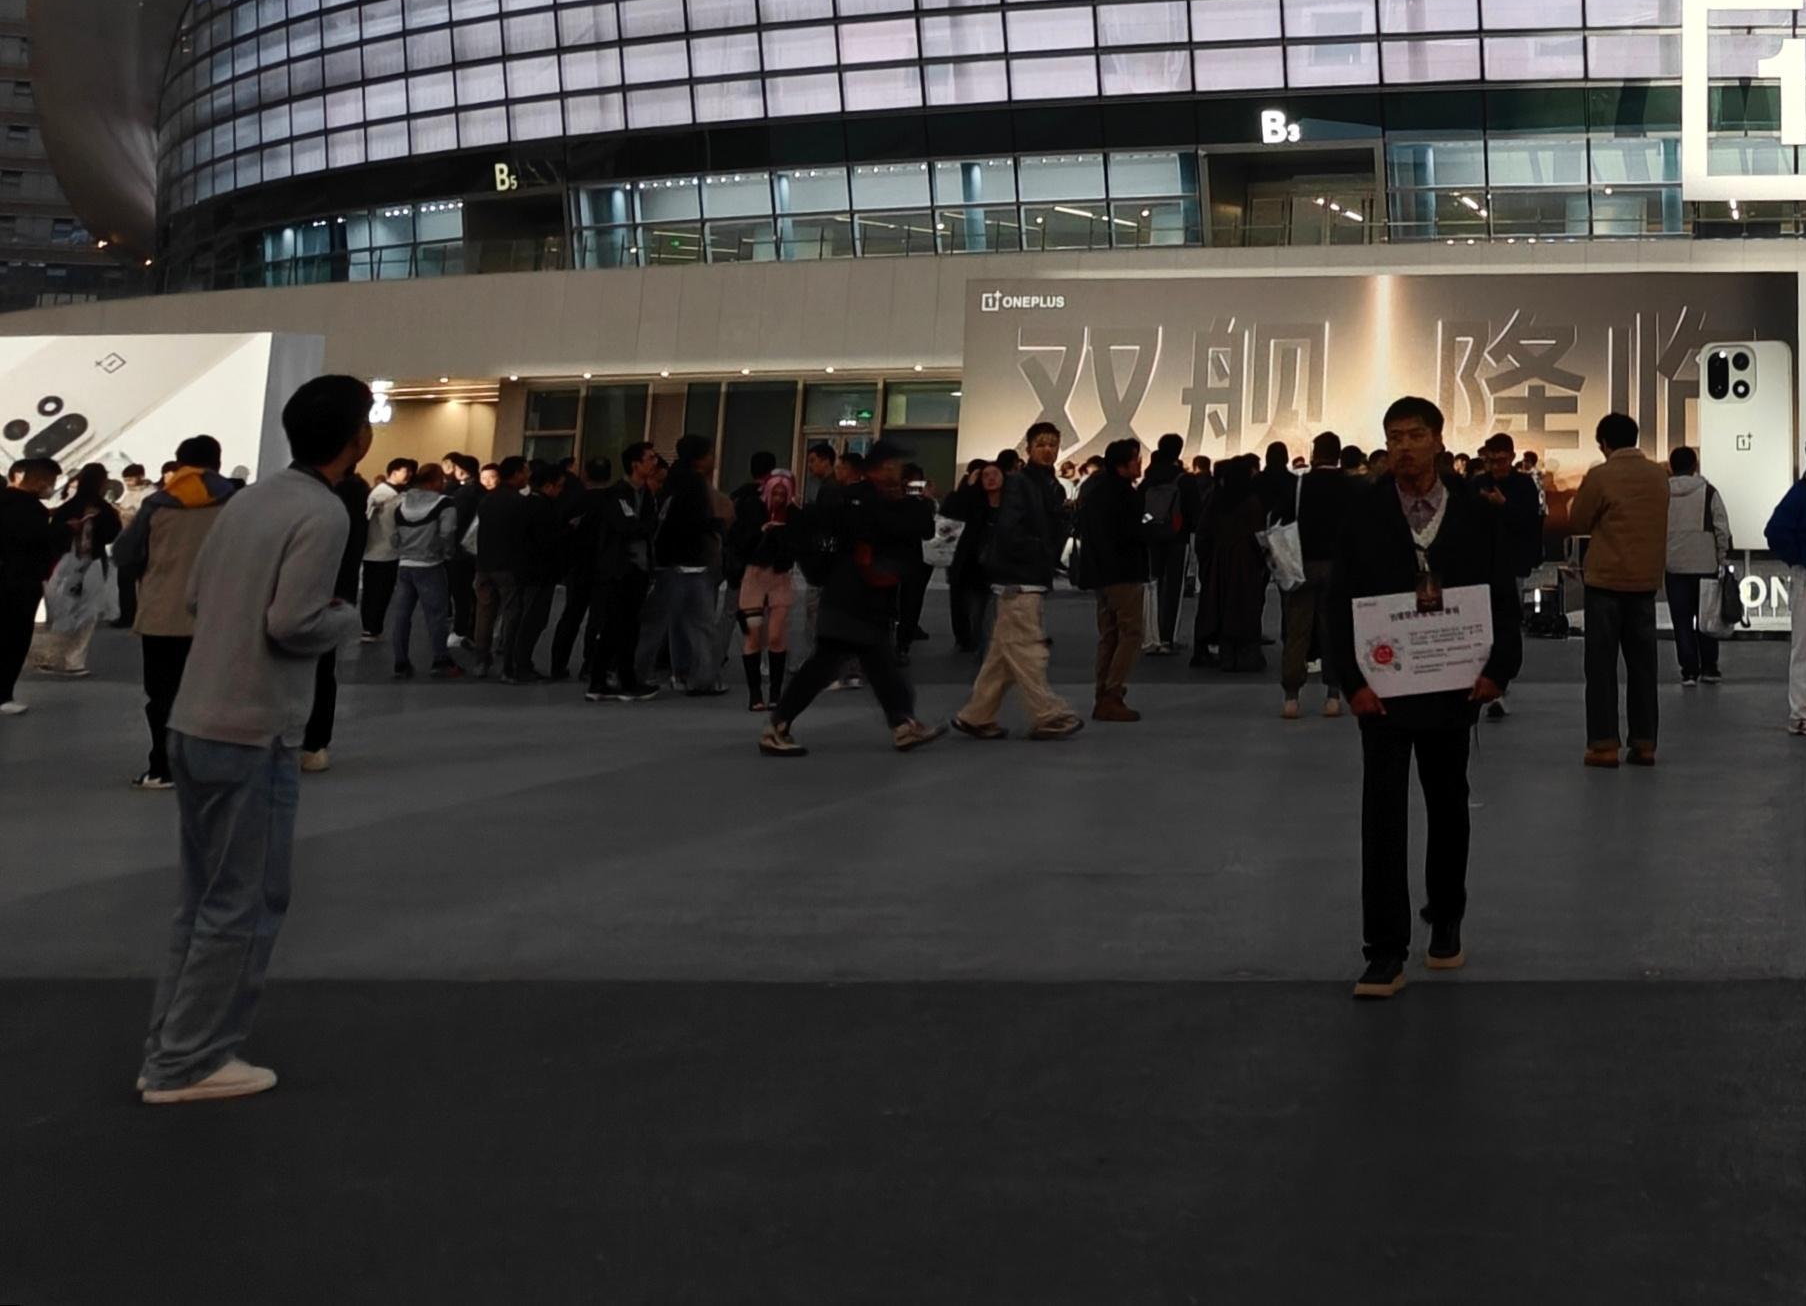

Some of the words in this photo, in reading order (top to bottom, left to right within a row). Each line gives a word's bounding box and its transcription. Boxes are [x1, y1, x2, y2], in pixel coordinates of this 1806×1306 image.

[1260, 109, 1301, 144] B3
[494, 162, 518, 191] B5
[1002, 296, 1065, 308] ONEPLUS
